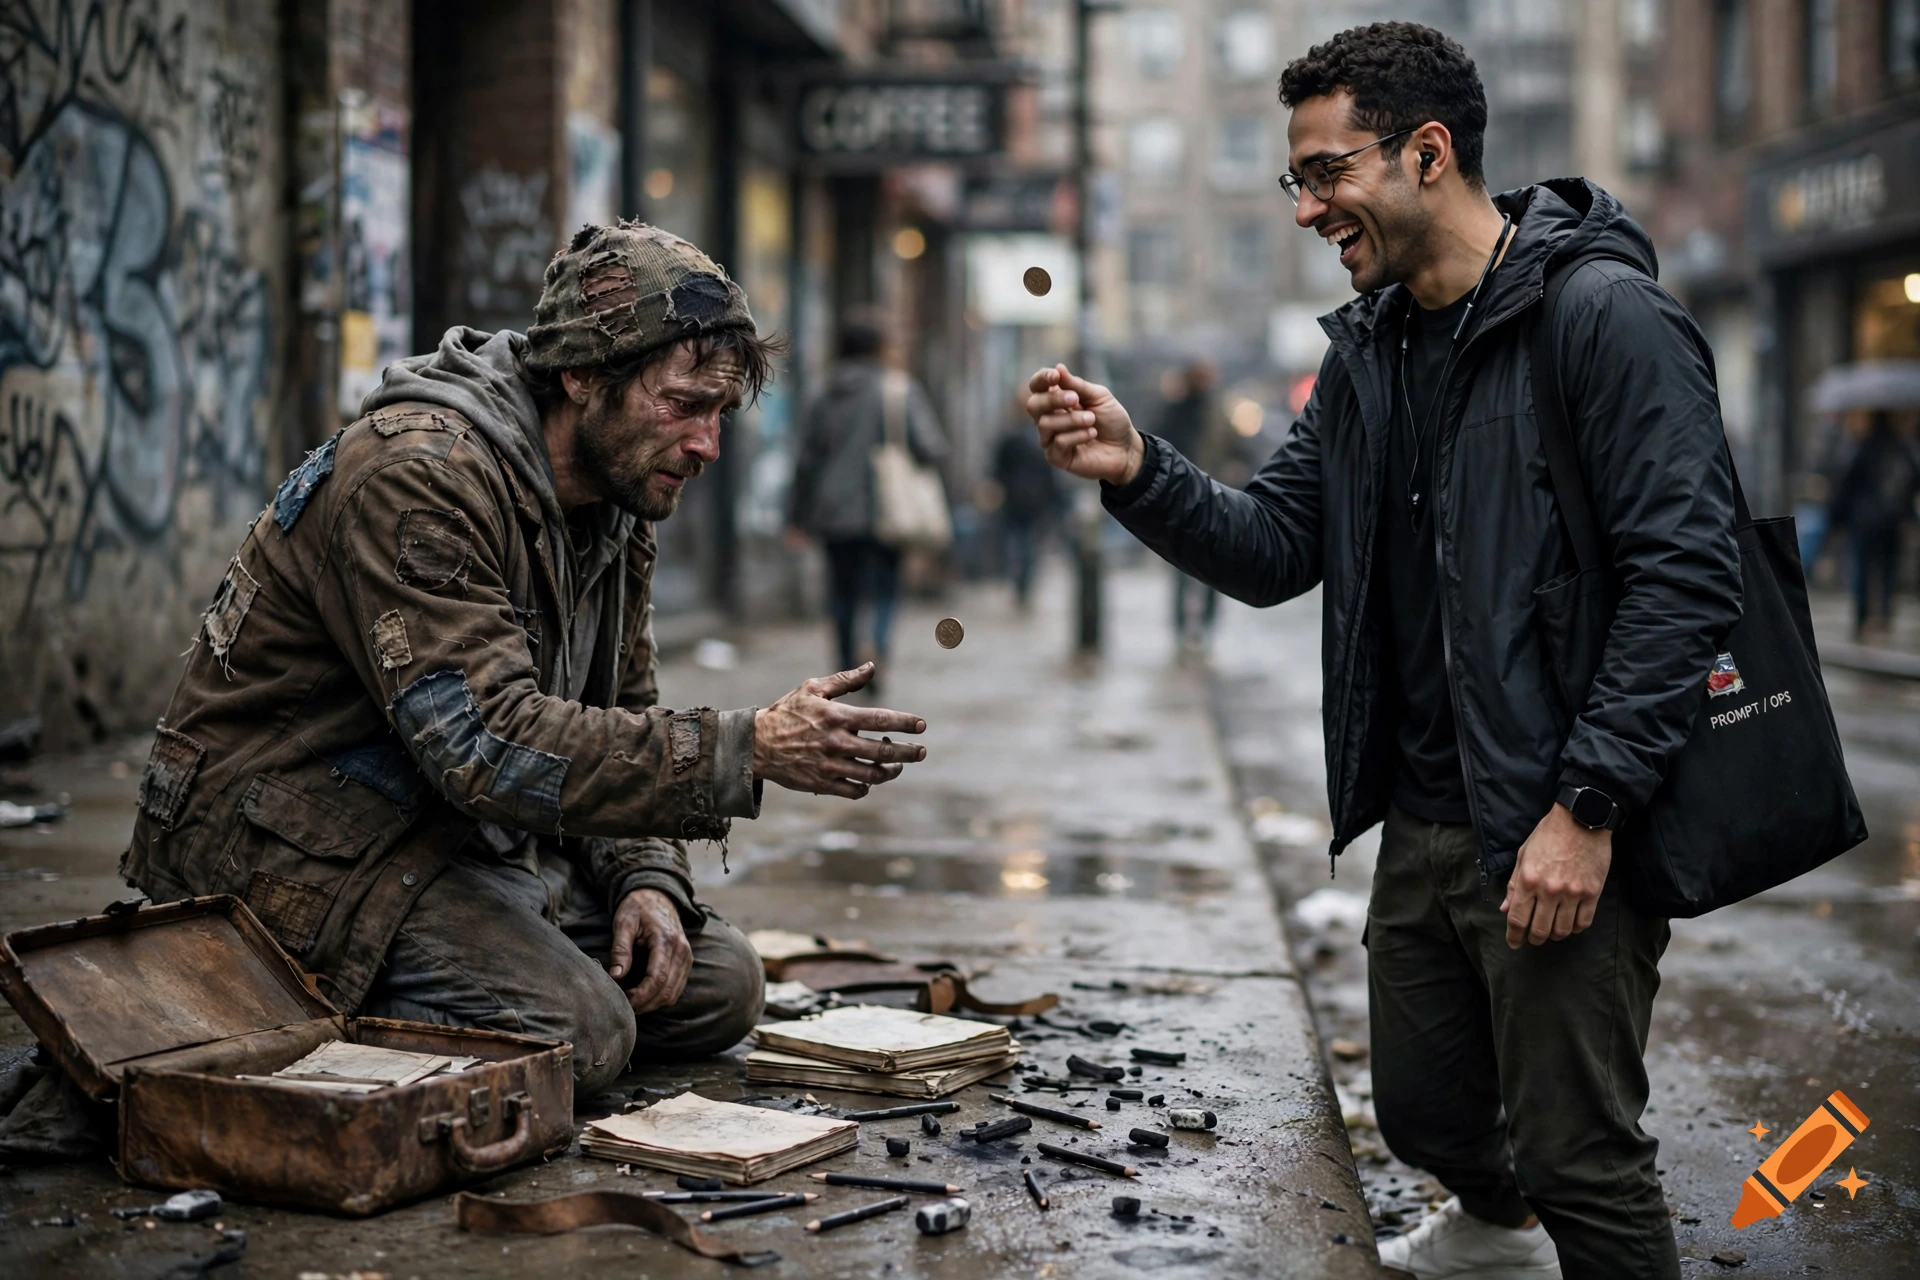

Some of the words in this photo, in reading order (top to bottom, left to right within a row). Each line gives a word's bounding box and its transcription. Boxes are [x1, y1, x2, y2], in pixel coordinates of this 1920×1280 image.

[803, 85, 988, 149] COFFEE
[1710, 702, 1759, 729] PROMPT
[1770, 691, 1792, 708] OPS
